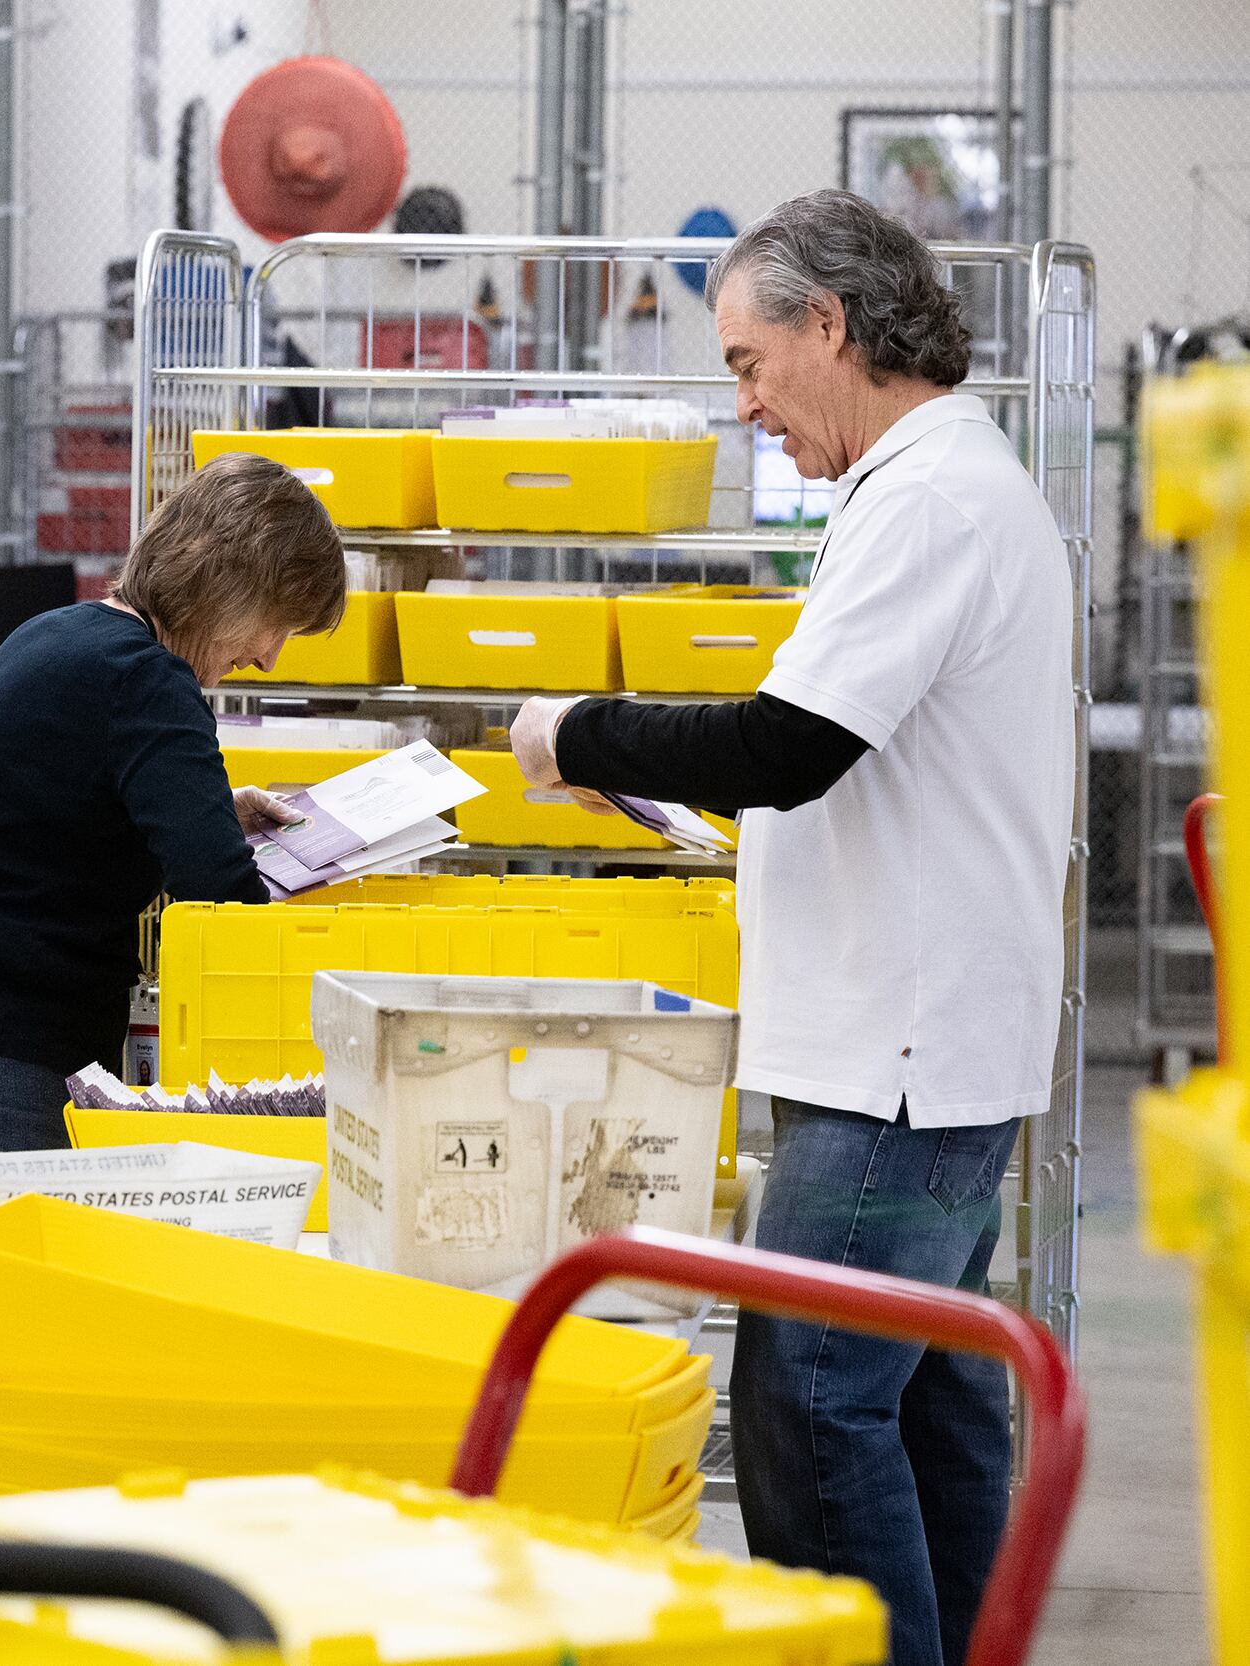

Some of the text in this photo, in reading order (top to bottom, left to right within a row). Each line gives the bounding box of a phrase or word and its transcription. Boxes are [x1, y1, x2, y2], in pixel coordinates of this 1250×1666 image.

[82, 1192, 154, 1208] STATES
[159, 1189, 229, 1206] POSTAL
[235, 1182, 308, 1202] SERVICE
